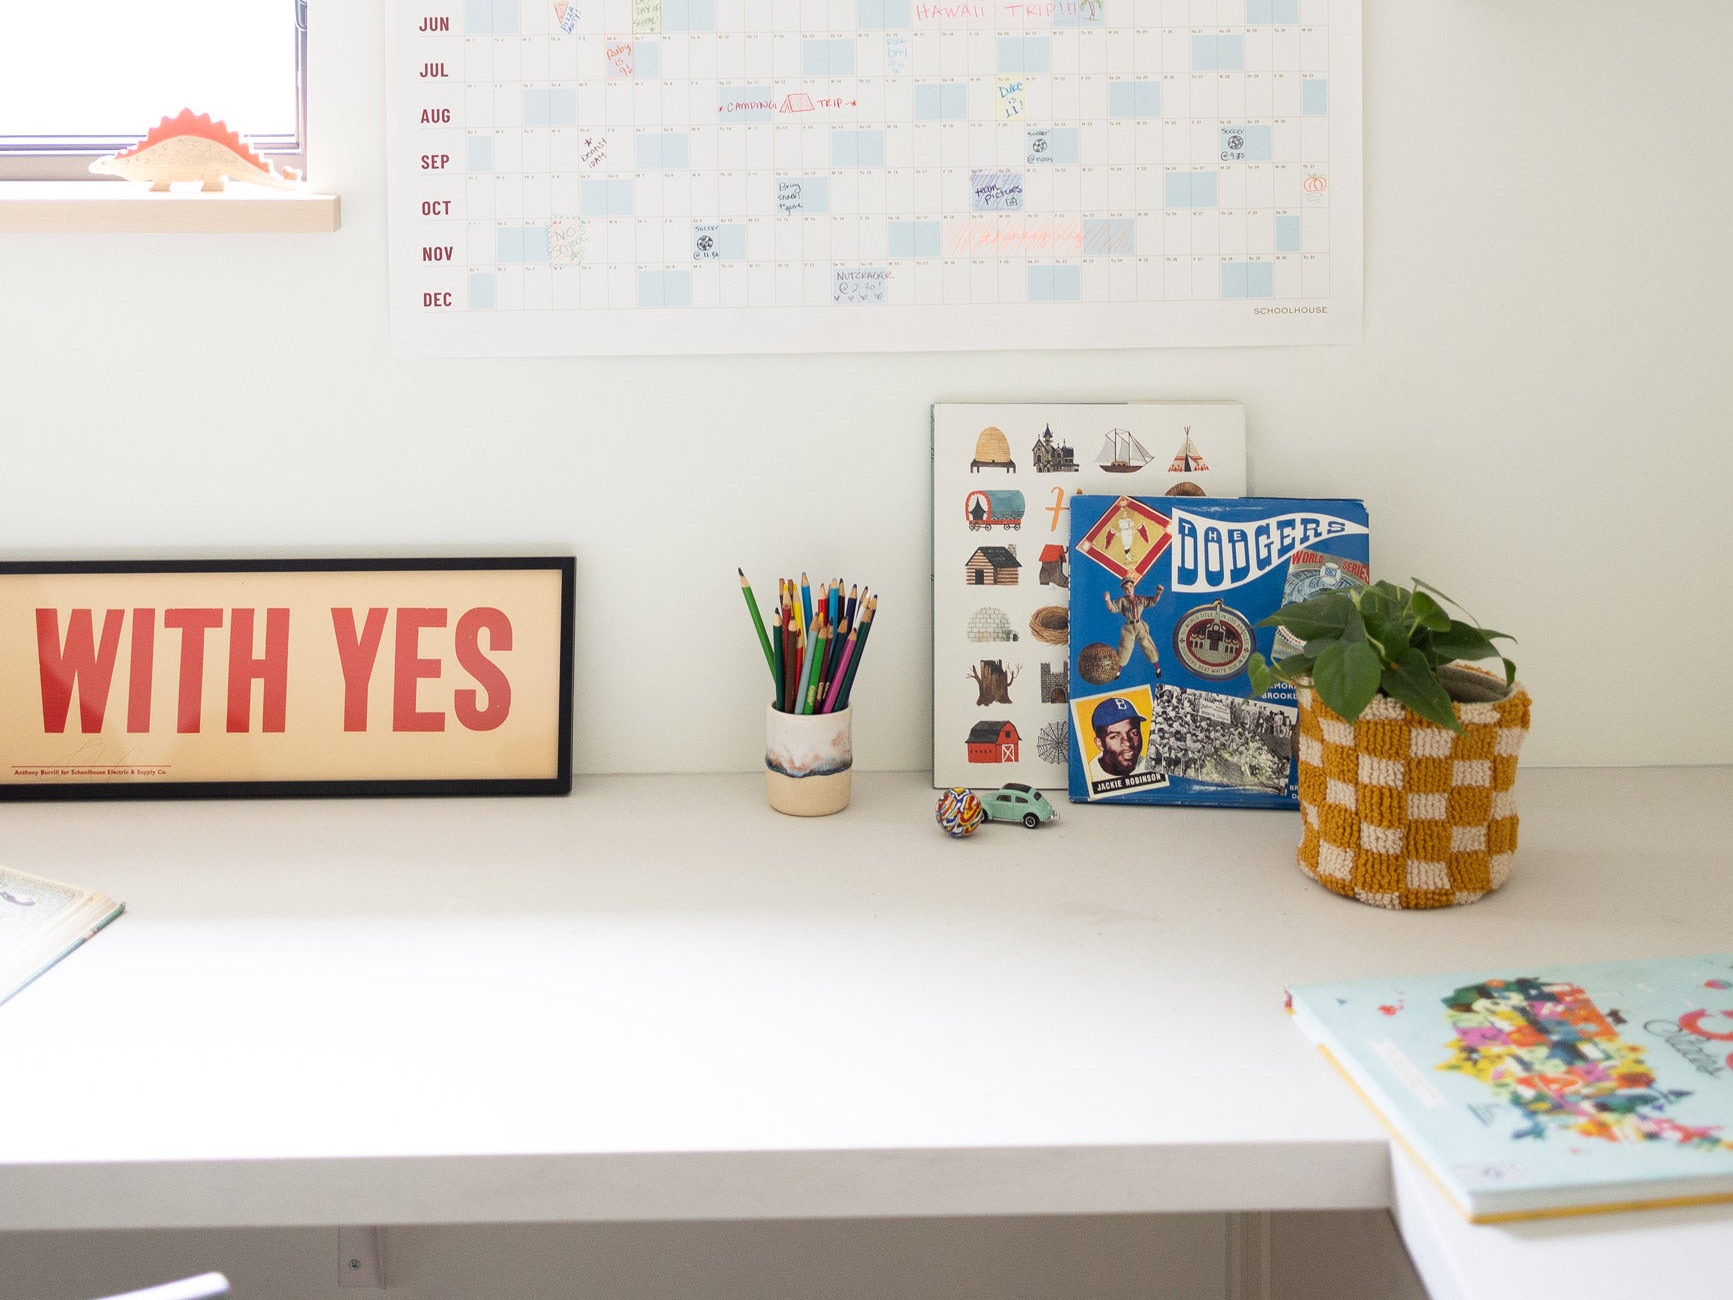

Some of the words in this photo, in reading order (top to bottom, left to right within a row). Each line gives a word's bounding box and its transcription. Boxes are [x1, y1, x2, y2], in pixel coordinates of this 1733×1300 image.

[419, 16, 450, 32] JUN
[420, 63, 449, 78] JUL
[727, 101, 777, 112] CAMPING
[817, 98, 842, 108] TRIP
[421, 108, 451, 124] AUG
[421, 154, 450, 170] SEP
[422, 200, 451, 216] OCT
[423, 246, 454, 262] NOV
[423, 292, 452, 308] DEC
[1254, 307, 1328, 315] SCHOOLHOUSE
[1177, 507, 1346, 586] DODGERS
[1291, 550, 1324, 565] WORLD
[35, 607, 291, 734] WITH
[330, 606, 513, 733] YES
[14, 769, 39, 777] Anthony
[136, 768, 157, 777] Supply
[1097, 782, 1123, 792] JACKIE
[1125, 773, 1161, 786] ROBINSON
